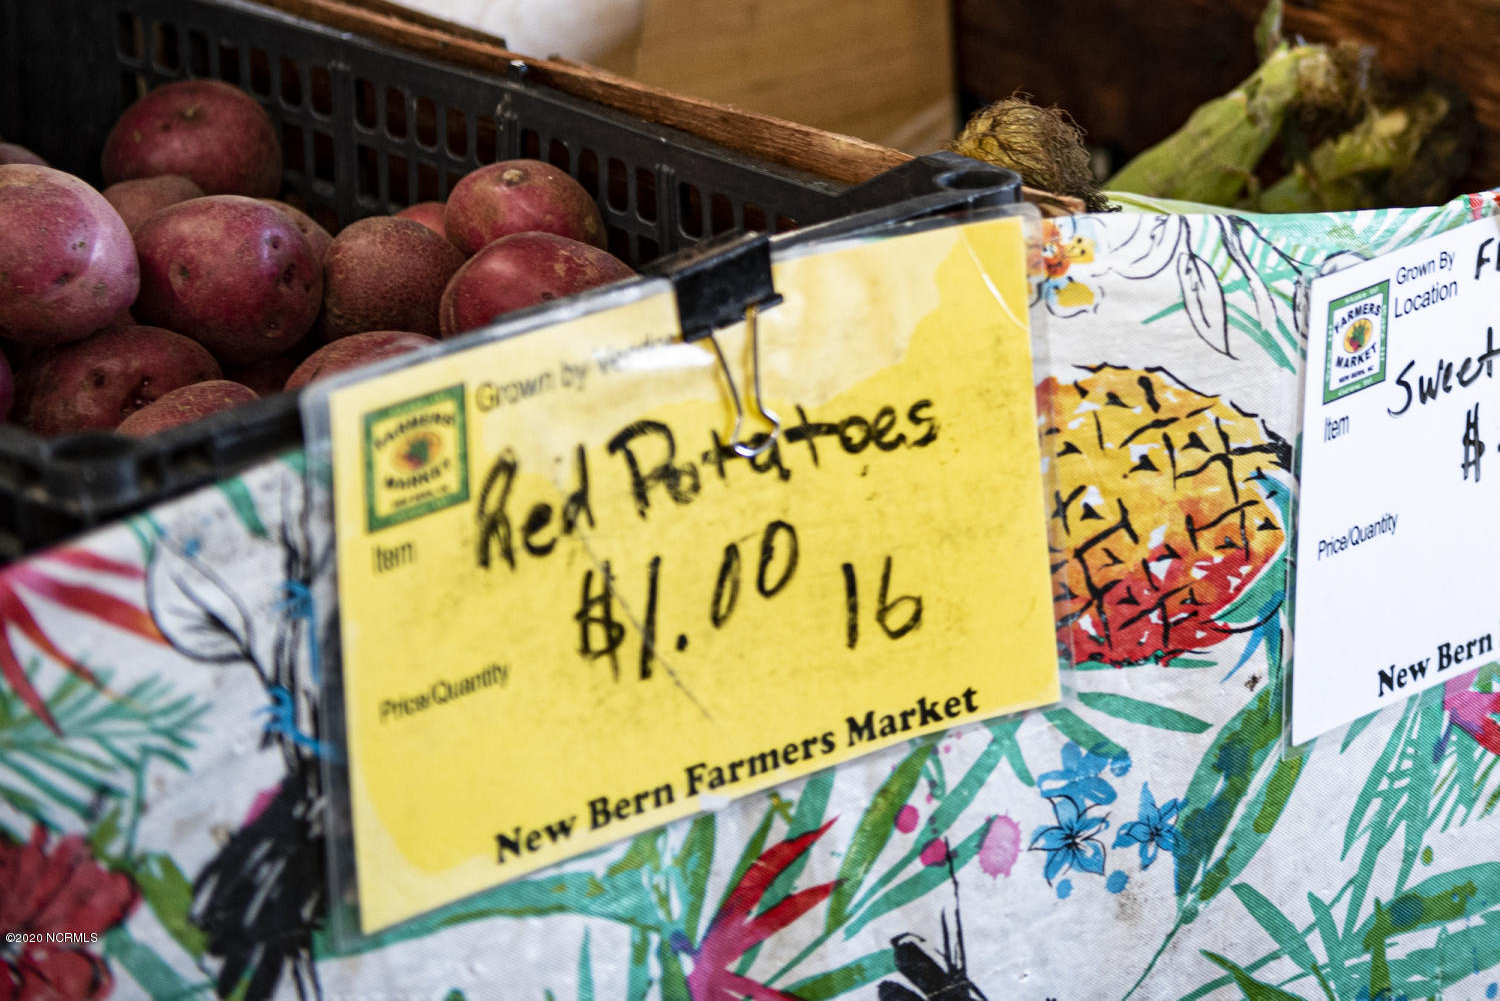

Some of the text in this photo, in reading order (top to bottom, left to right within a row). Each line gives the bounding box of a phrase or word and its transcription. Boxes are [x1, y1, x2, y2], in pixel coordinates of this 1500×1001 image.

[1396, 250, 1456, 285] Grown By
[1334, 302, 1382, 334] FARMERS
[1394, 280, 1459, 319] Location
[1335, 342, 1377, 369] MARKET
[475, 371, 555, 412] Grown
[560, 360, 588, 392] by
[1324, 415, 1350, 443] Item
[477, 399, 938, 571] Red Potatoes
[373, 539, 414, 576] Item
[1317, 512, 1399, 561] Price/Quantity
[574, 519, 800, 683] $1.00
[1377, 657, 1431, 698] New
[1436, 632, 1493, 673] Bern
[379, 662, 510, 725] Price/Quantity
[494, 686, 980, 865] New Bern Farmers Market
